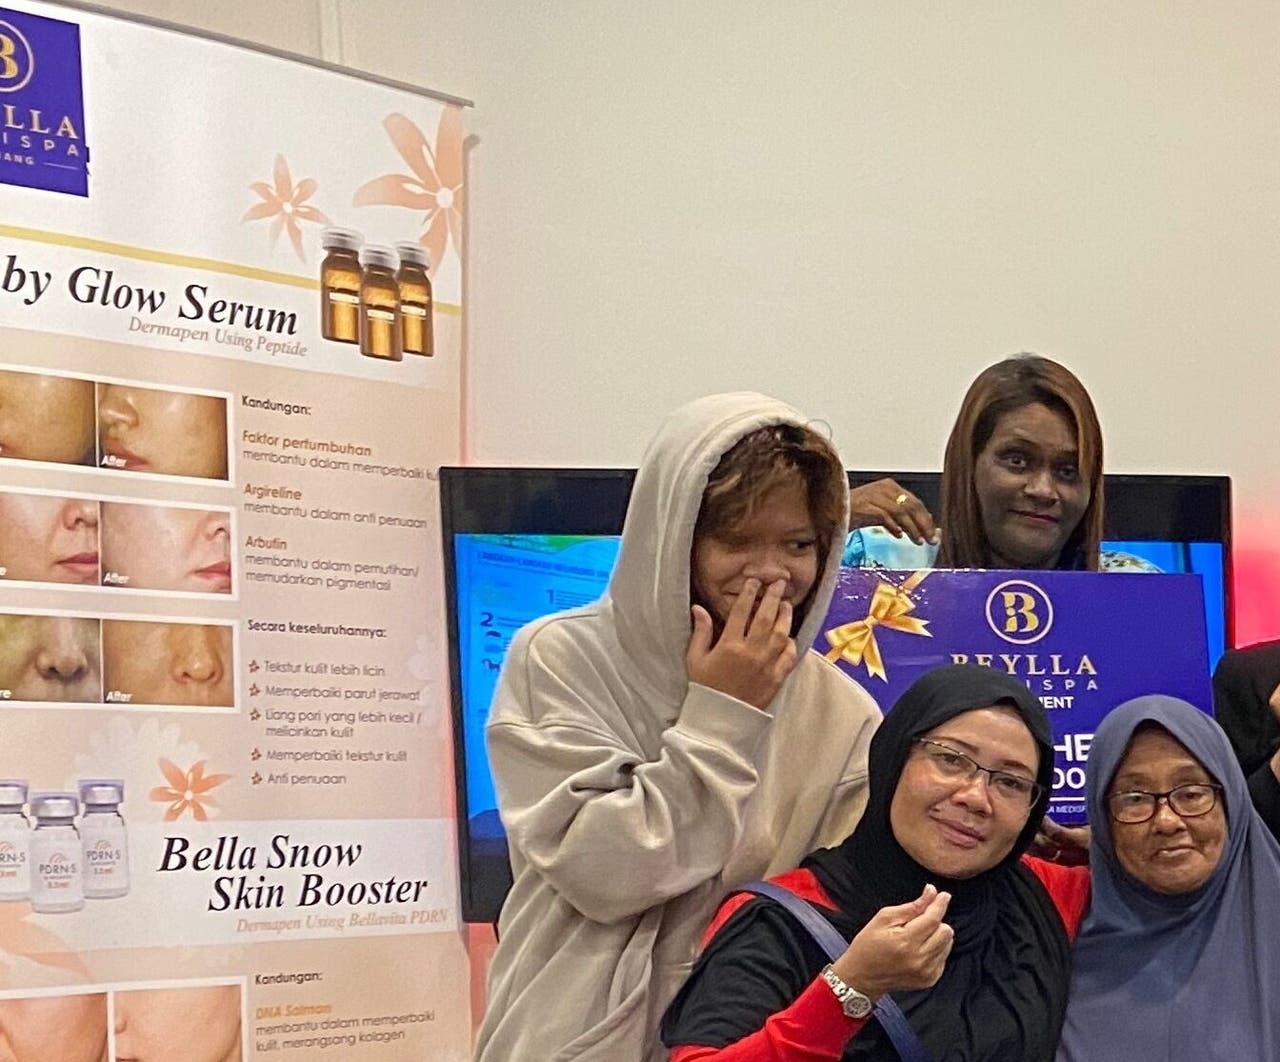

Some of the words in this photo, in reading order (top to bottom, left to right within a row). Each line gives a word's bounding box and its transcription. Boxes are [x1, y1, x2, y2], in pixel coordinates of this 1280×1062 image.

[3, 104, 78, 139] LLA
[3, 132, 79, 157] ISPA
[0, 151, 34, 165] ANG
[2, 255, 52, 305] by
[68, 266, 167, 315] Glow
[178, 284, 299, 336] Serum
[128, 316, 209, 344] Dermapen
[214, 328, 254, 350] Using
[256, 335, 308, 358] Peptide
[242, 395, 311, 416] Kandungan:
[243, 430, 279, 447] Faktor
[282, 435, 371, 456] pertumbuhan
[243, 450, 306, 466] membantu
[310, 457, 349, 471] dalam
[244, 483, 302, 500] Argireline
[244, 502, 307, 518] membantu
[311, 509, 350, 522] dalam
[354, 513, 375, 524] anti
[379, 515, 427, 529] penuaan
[245, 535, 287, 550] Arbutin
[245, 554, 308, 570] membantu
[312, 560, 351, 573] dalam
[327, 576, 391, 591] pigmentasi
[248, 620, 285, 632] Secara
[289, 622, 387, 638] keseluruhannya:
[264, 661, 301, 673] Tekstur
[331, 664, 360, 676] lebih
[1026, 679, 1098, 691] ISPA
[1039, 696, 1074, 709] ENT
[266, 709, 295, 723] Liang
[325, 712, 356, 725] yang
[358, 712, 386, 723] lebih
[267, 773, 289, 784] Anti
[291, 775, 346, 787] penuaan
[157, 836, 256, 872] Bella
[266, 834, 363, 869] Snow
[207, 875, 284, 911] Skin
[299, 873, 428, 907] Booster
[236, 918, 300, 934] Dermapen
[306, 915, 345, 930] Using
[410, 908, 448, 923] PDRN
[255, 972, 323, 986] Kandungan:
[256, 1021, 318, 1036] membantu
[321, 1018, 359, 1030] dalam
